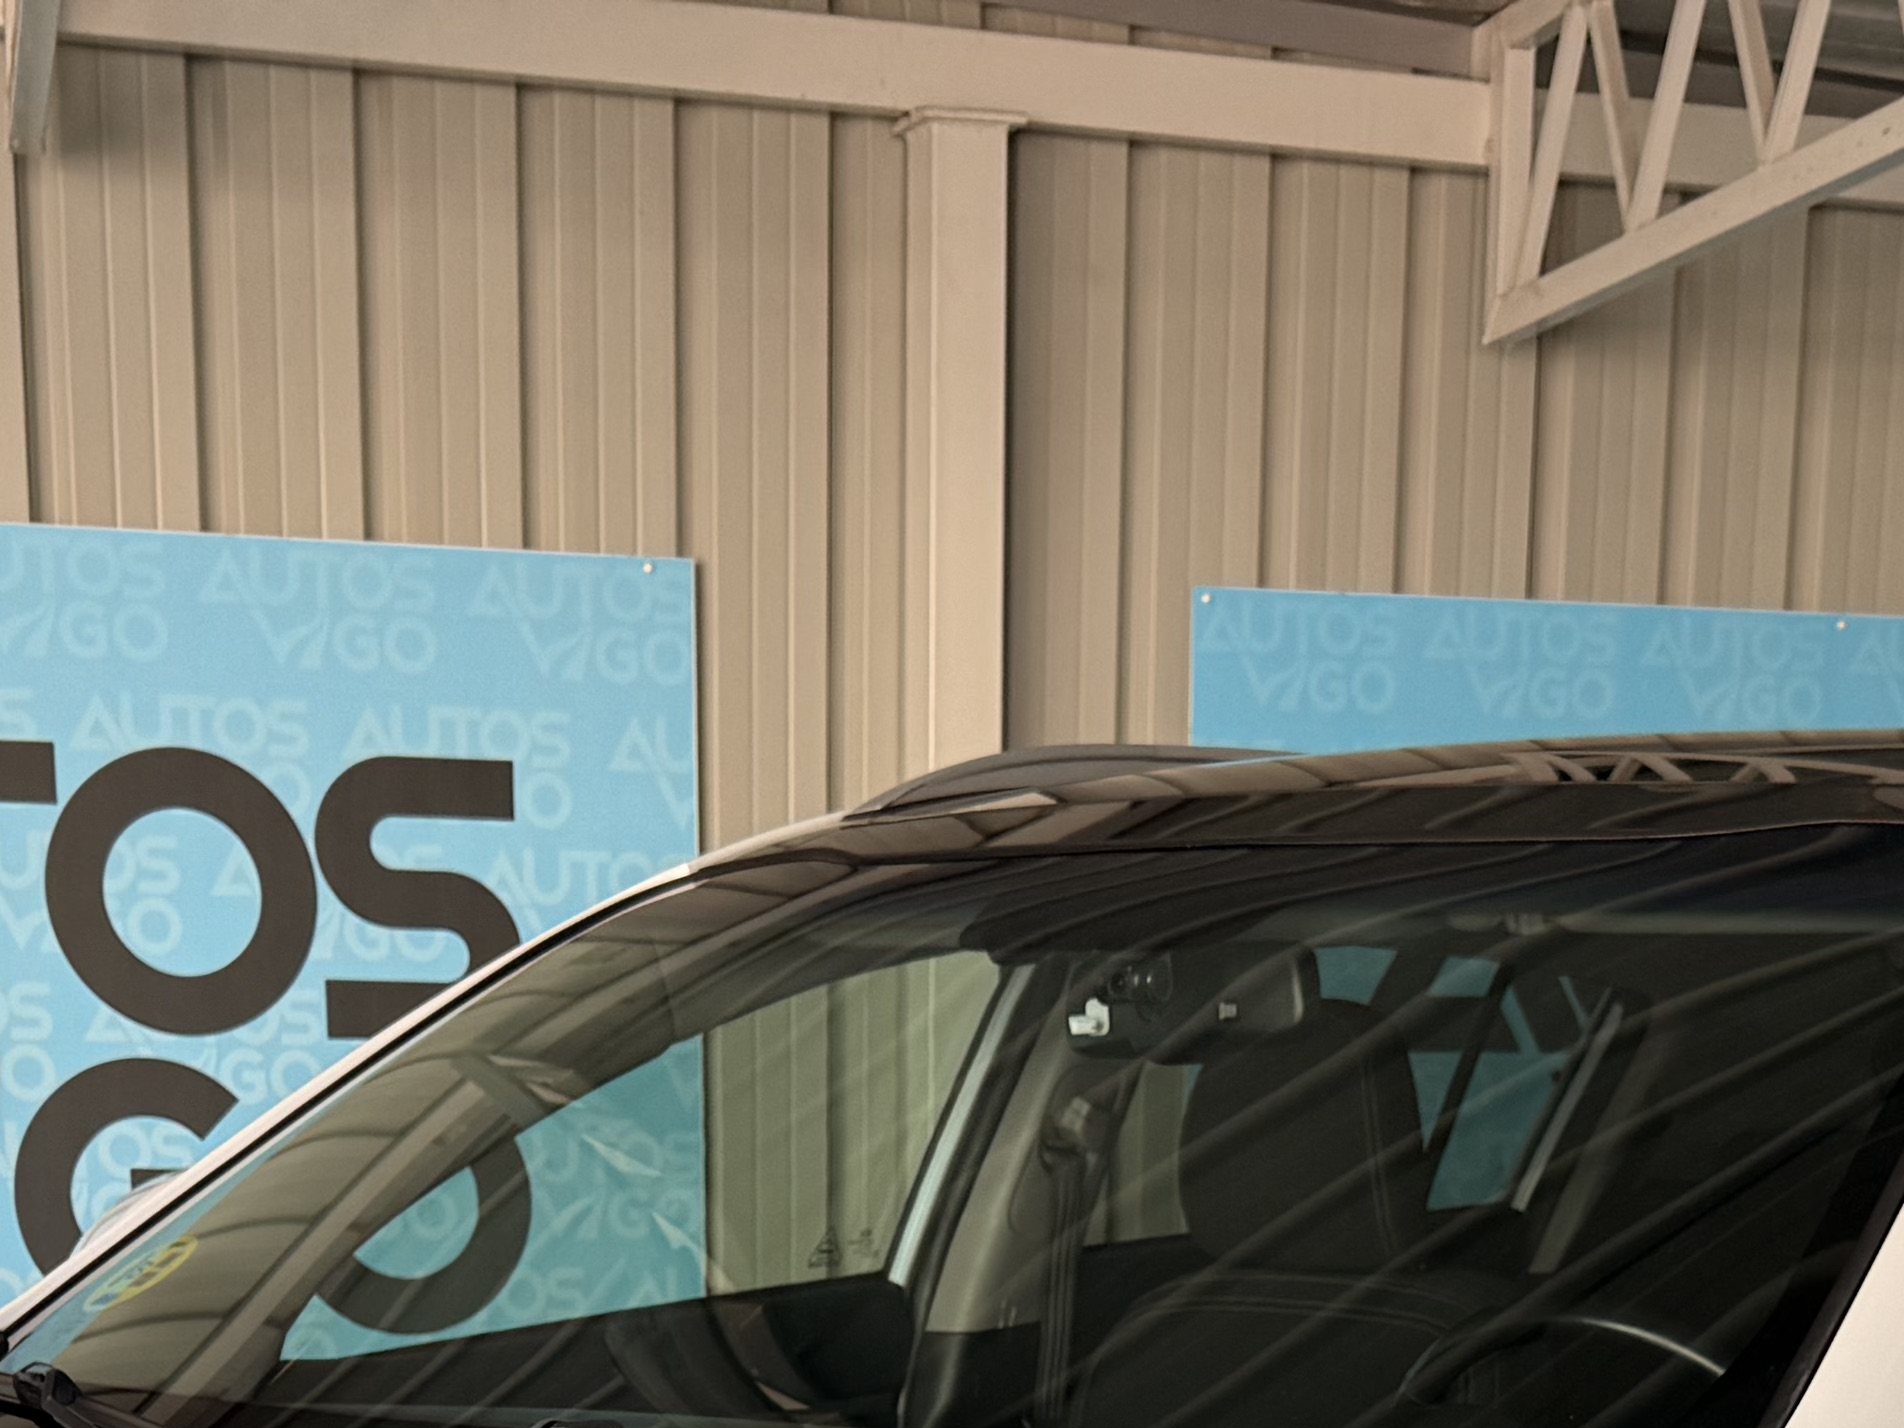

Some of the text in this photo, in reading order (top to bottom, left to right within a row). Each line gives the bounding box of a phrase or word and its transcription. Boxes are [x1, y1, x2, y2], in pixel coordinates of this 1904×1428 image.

[202, 549, 433, 612] AUTOS
[468, 563, 691, 624] AUTOS
[252, 610, 435, 673] VIGO
[519, 619, 691, 683] VIGO
[1200, 602, 1393, 656] AUTOS
[1425, 608, 1614, 662] AUTOS
[1640, 616, 1820, 669] AUTOS
[1242, 657, 1393, 712] VIGO
[1468, 666, 1612, 718] VIGO
[1680, 672, 1819, 724] VIGO
[69, 691, 308, 756] AUTOS
[343, 707, 568, 766] AUTOS
